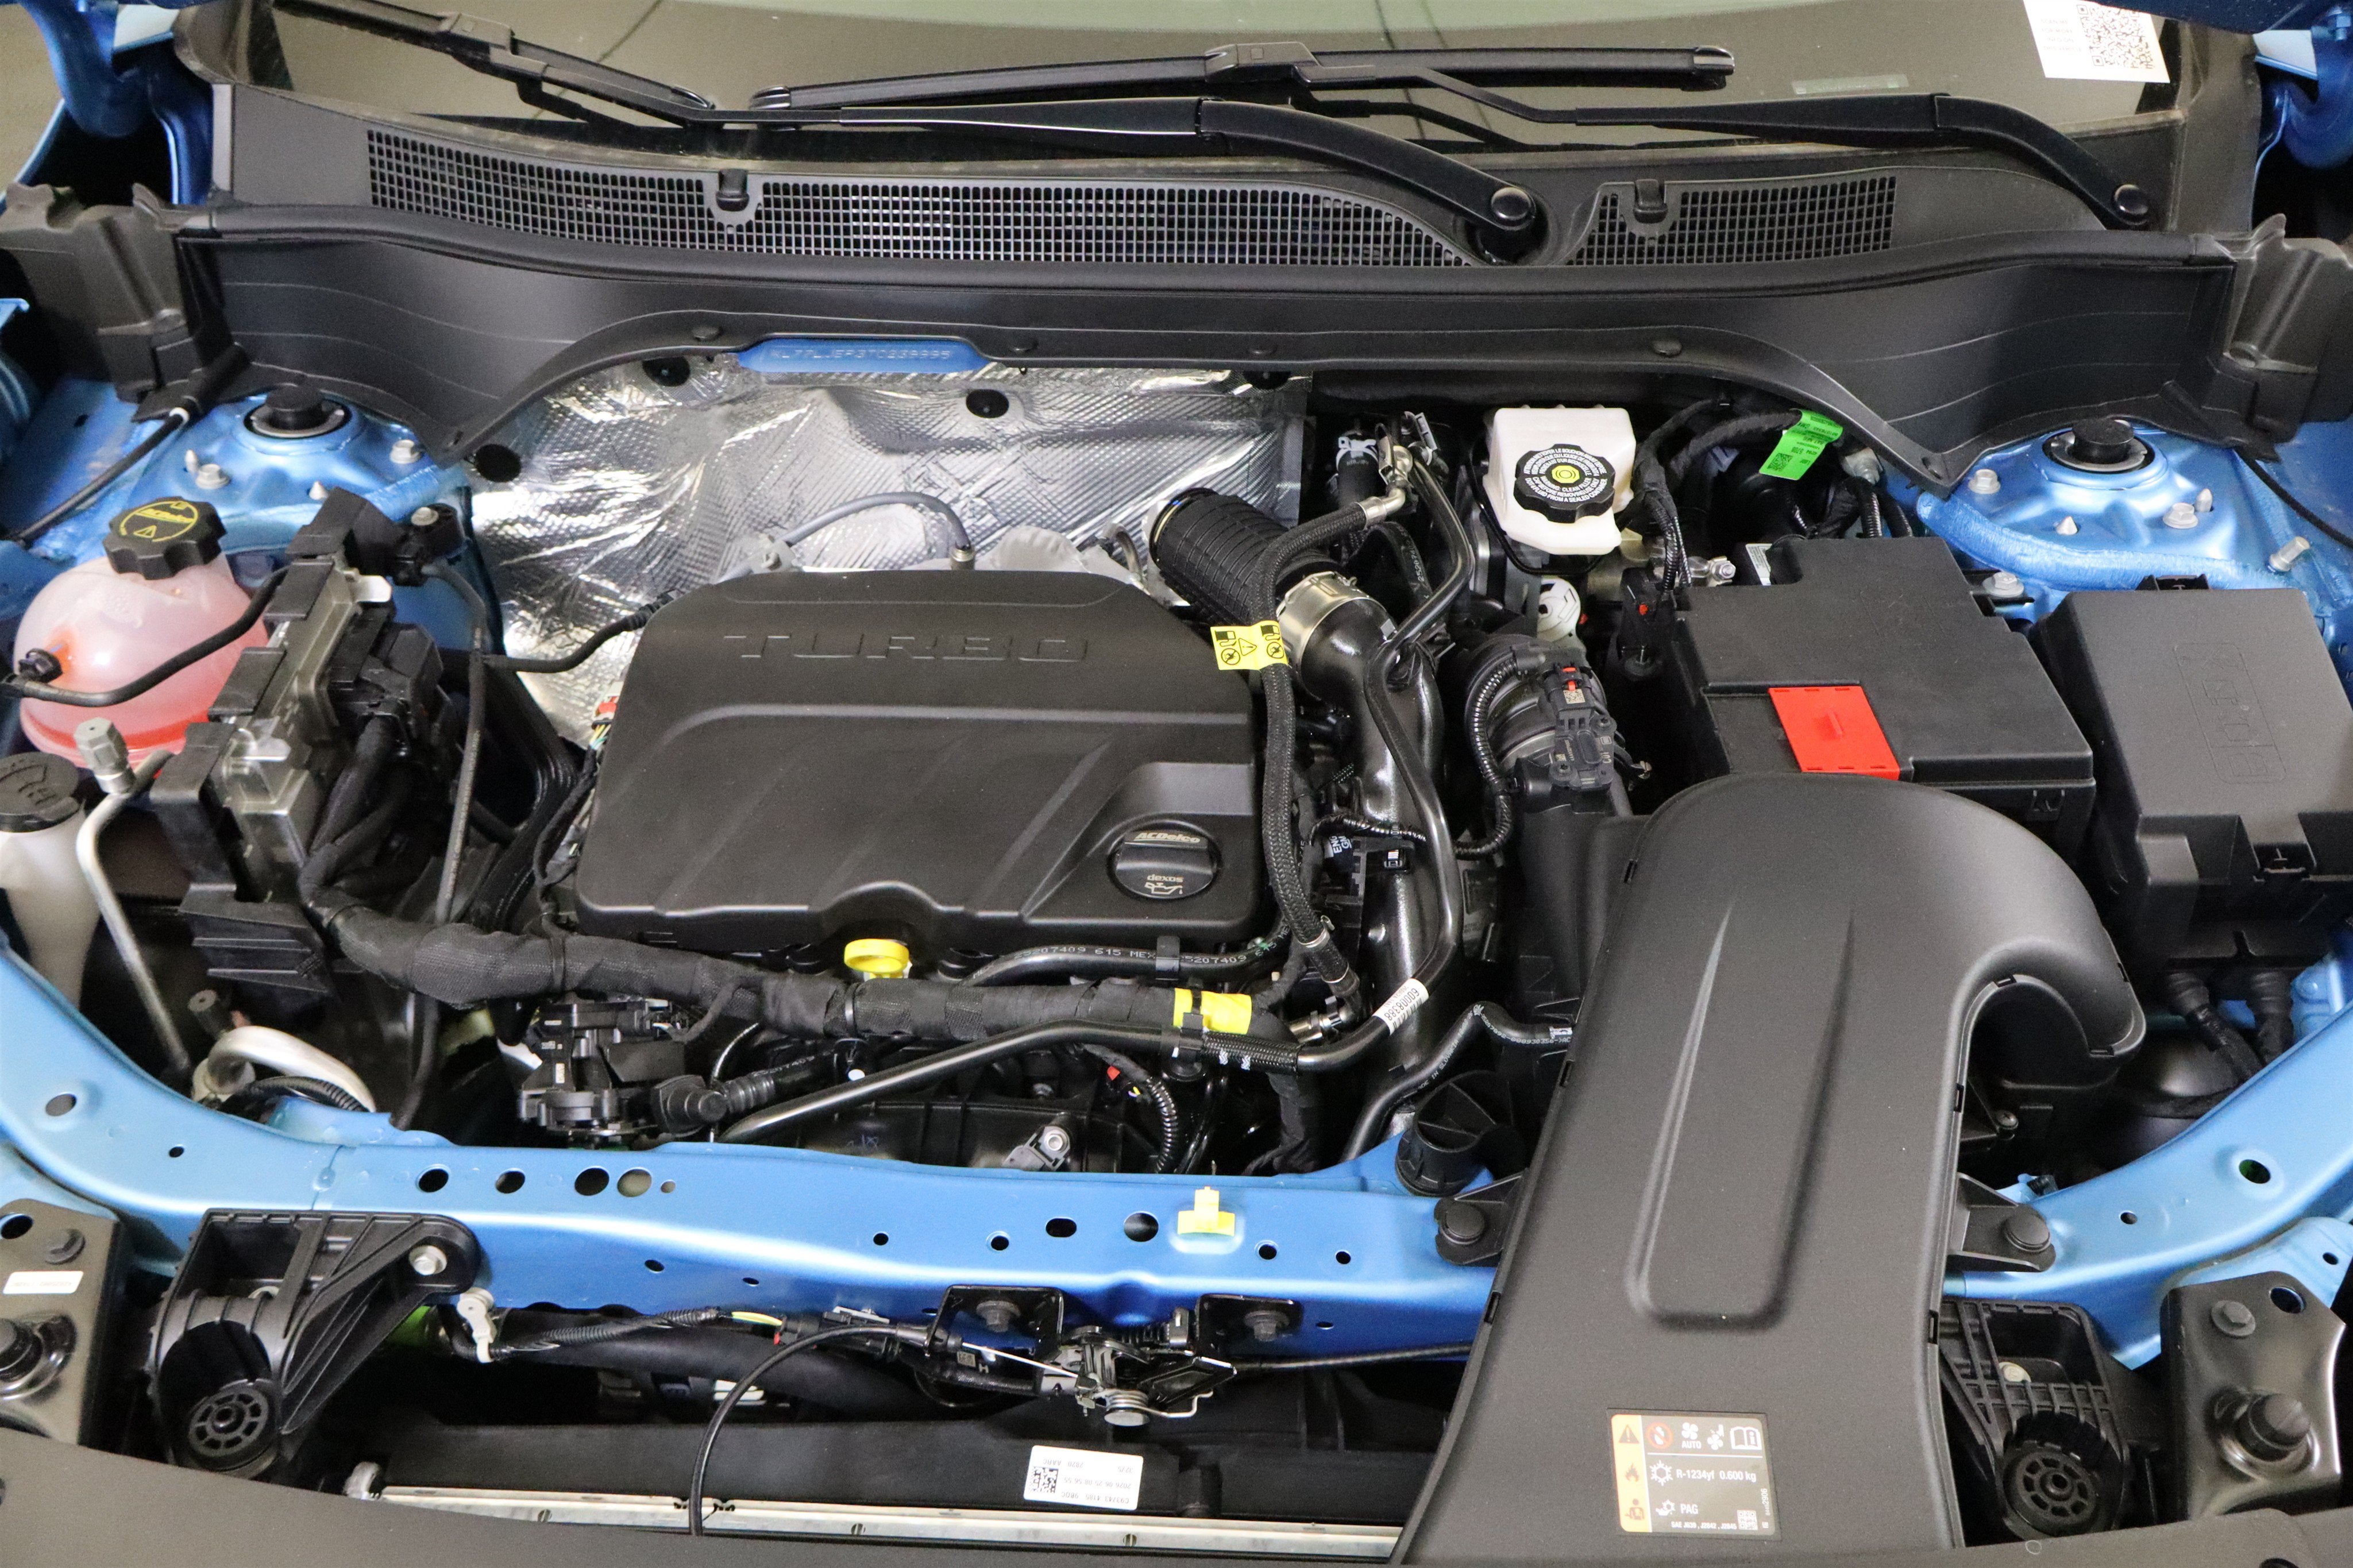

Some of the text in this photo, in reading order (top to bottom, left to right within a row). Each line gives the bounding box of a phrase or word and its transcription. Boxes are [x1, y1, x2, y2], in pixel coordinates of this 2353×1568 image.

[1547, 493, 1563, 502] FROM
[1569, 495, 1590, 503] SEALED
[724, 634, 1088, 662] TURBO
[1134, 832, 1200, 843] ACDelco
[1147, 874, 1184, 882] dexos
[1094, 948, 1122, 956] 615
[1384, 988, 1420, 1021] 60008388
[1681, 1440, 1702, 1449] AUTO
[1676, 1469, 1757, 1483] R-1234yf 0.600 kg
[1680, 1504, 1699, 1515] PAG
